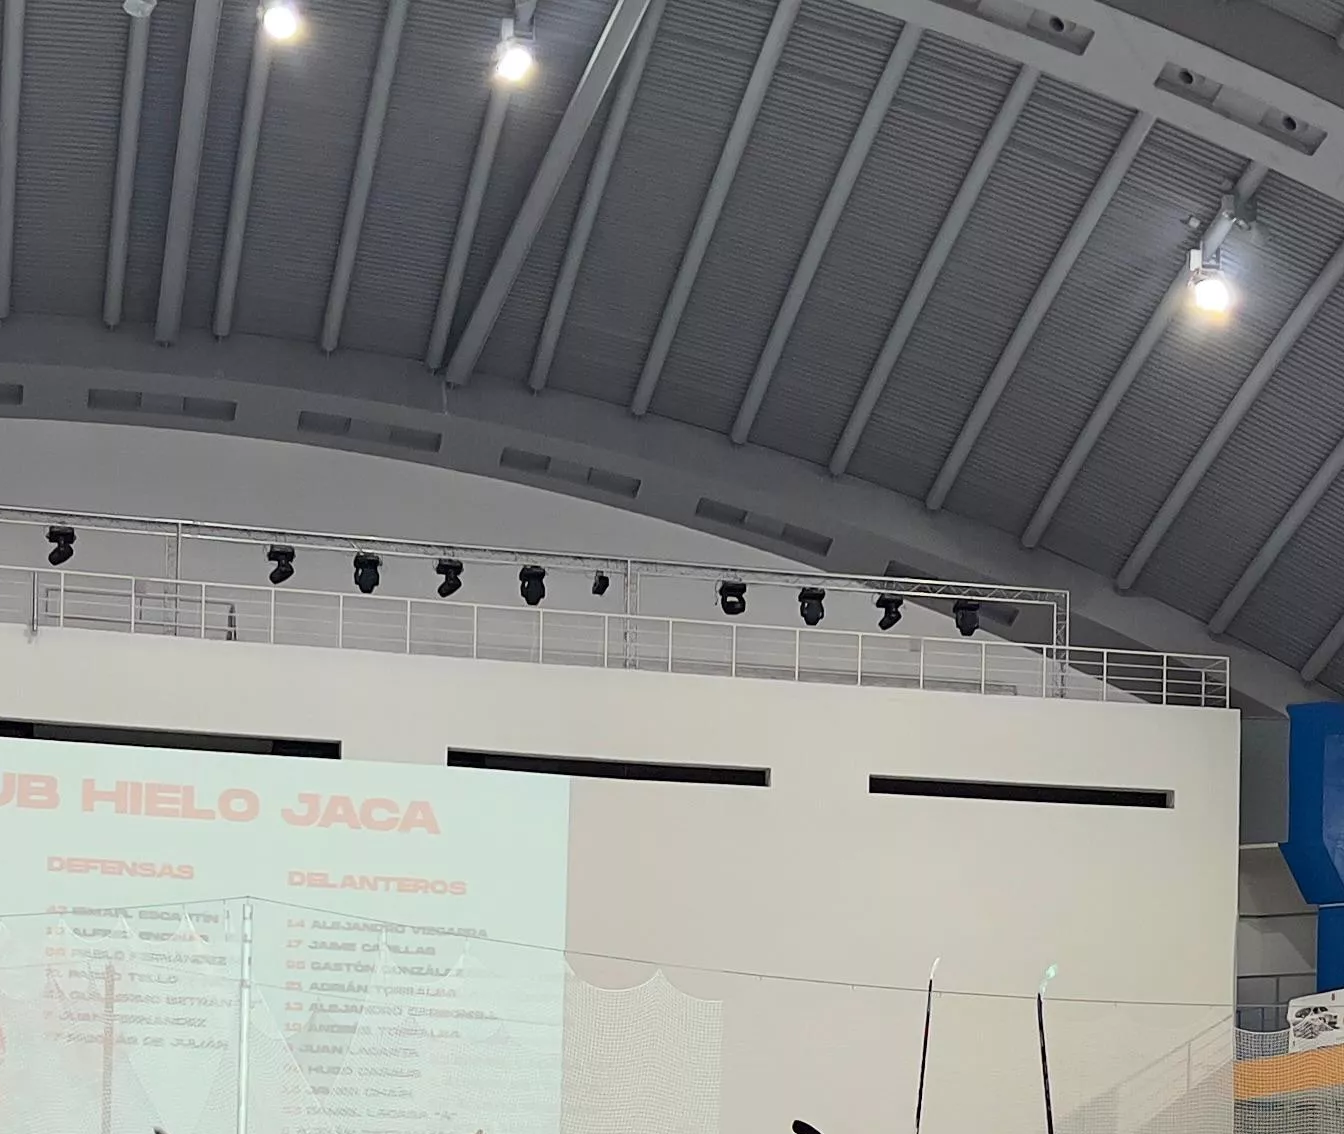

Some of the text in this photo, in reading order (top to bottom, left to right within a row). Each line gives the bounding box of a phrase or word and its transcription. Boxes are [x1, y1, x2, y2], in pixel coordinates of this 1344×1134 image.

[82, 778, 260, 823] HIELO
[281, 793, 440, 834] JACA
[47, 856, 194, 880] DEFENSAS
[287, 870, 467, 895] DELANTEROS
